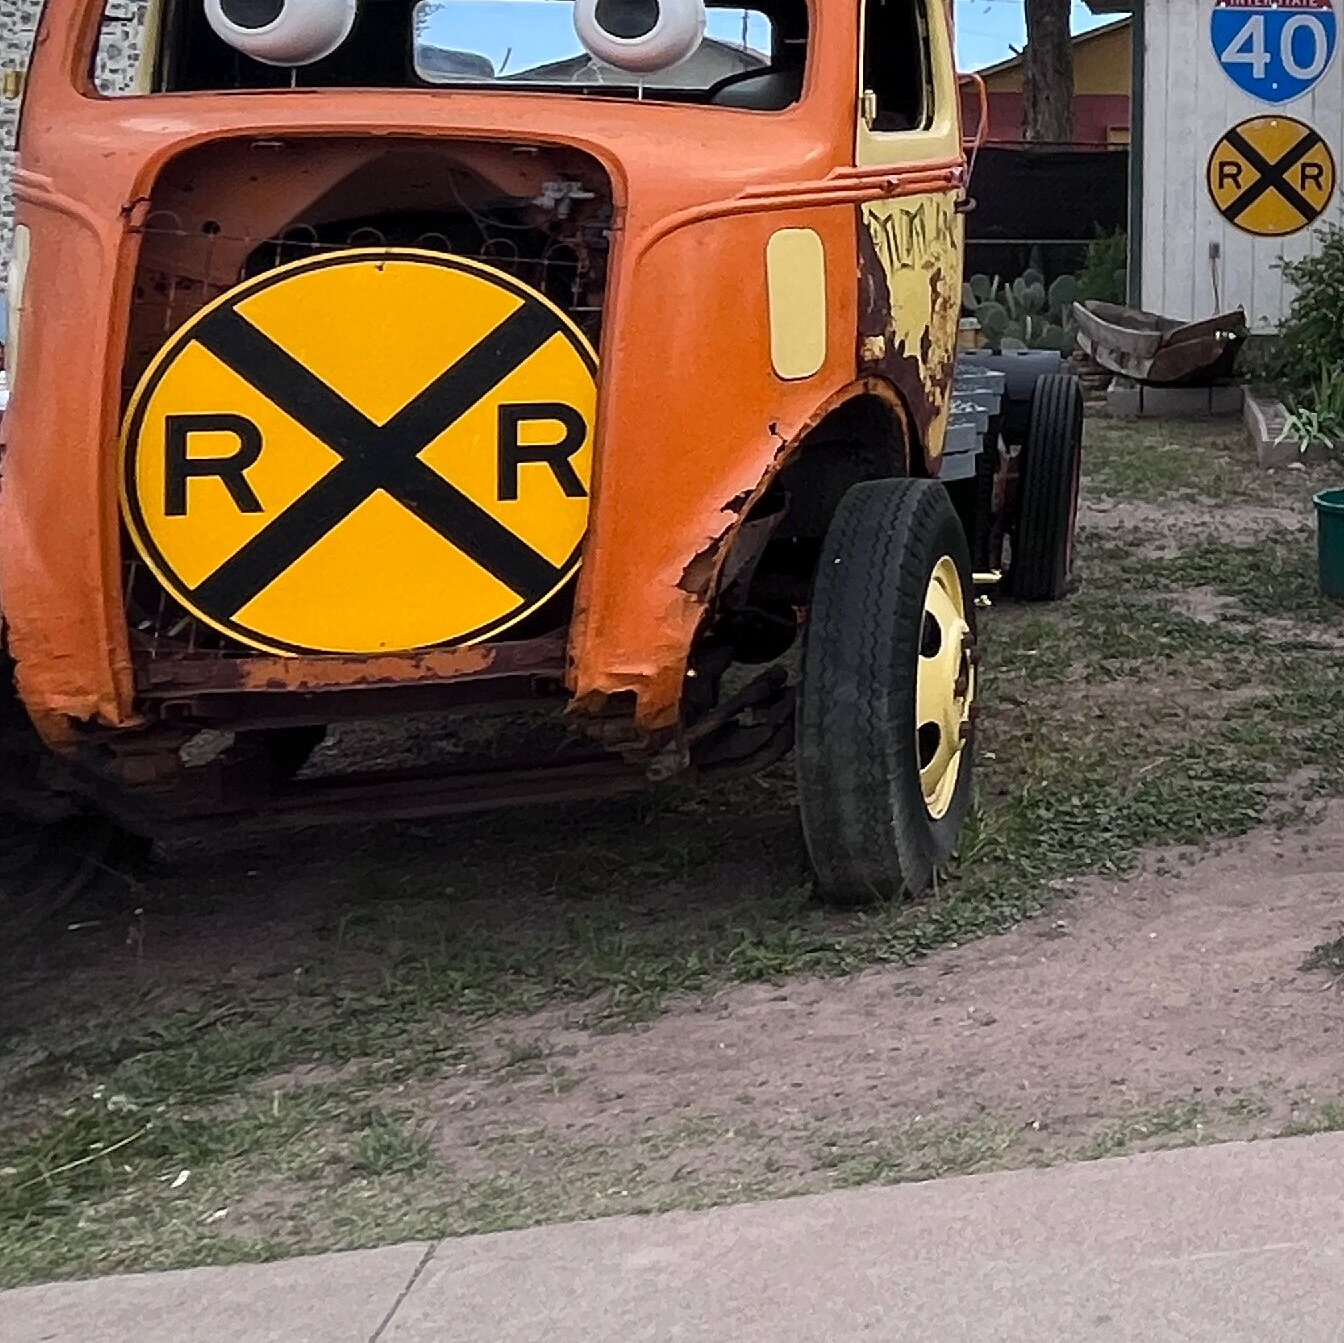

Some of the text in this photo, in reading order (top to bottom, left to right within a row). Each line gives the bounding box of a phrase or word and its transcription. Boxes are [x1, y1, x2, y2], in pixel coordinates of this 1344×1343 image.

[1220, 14, 1328, 81] 40
[1218, 160, 1325, 191] R R
[163, 403, 589, 516] R R
